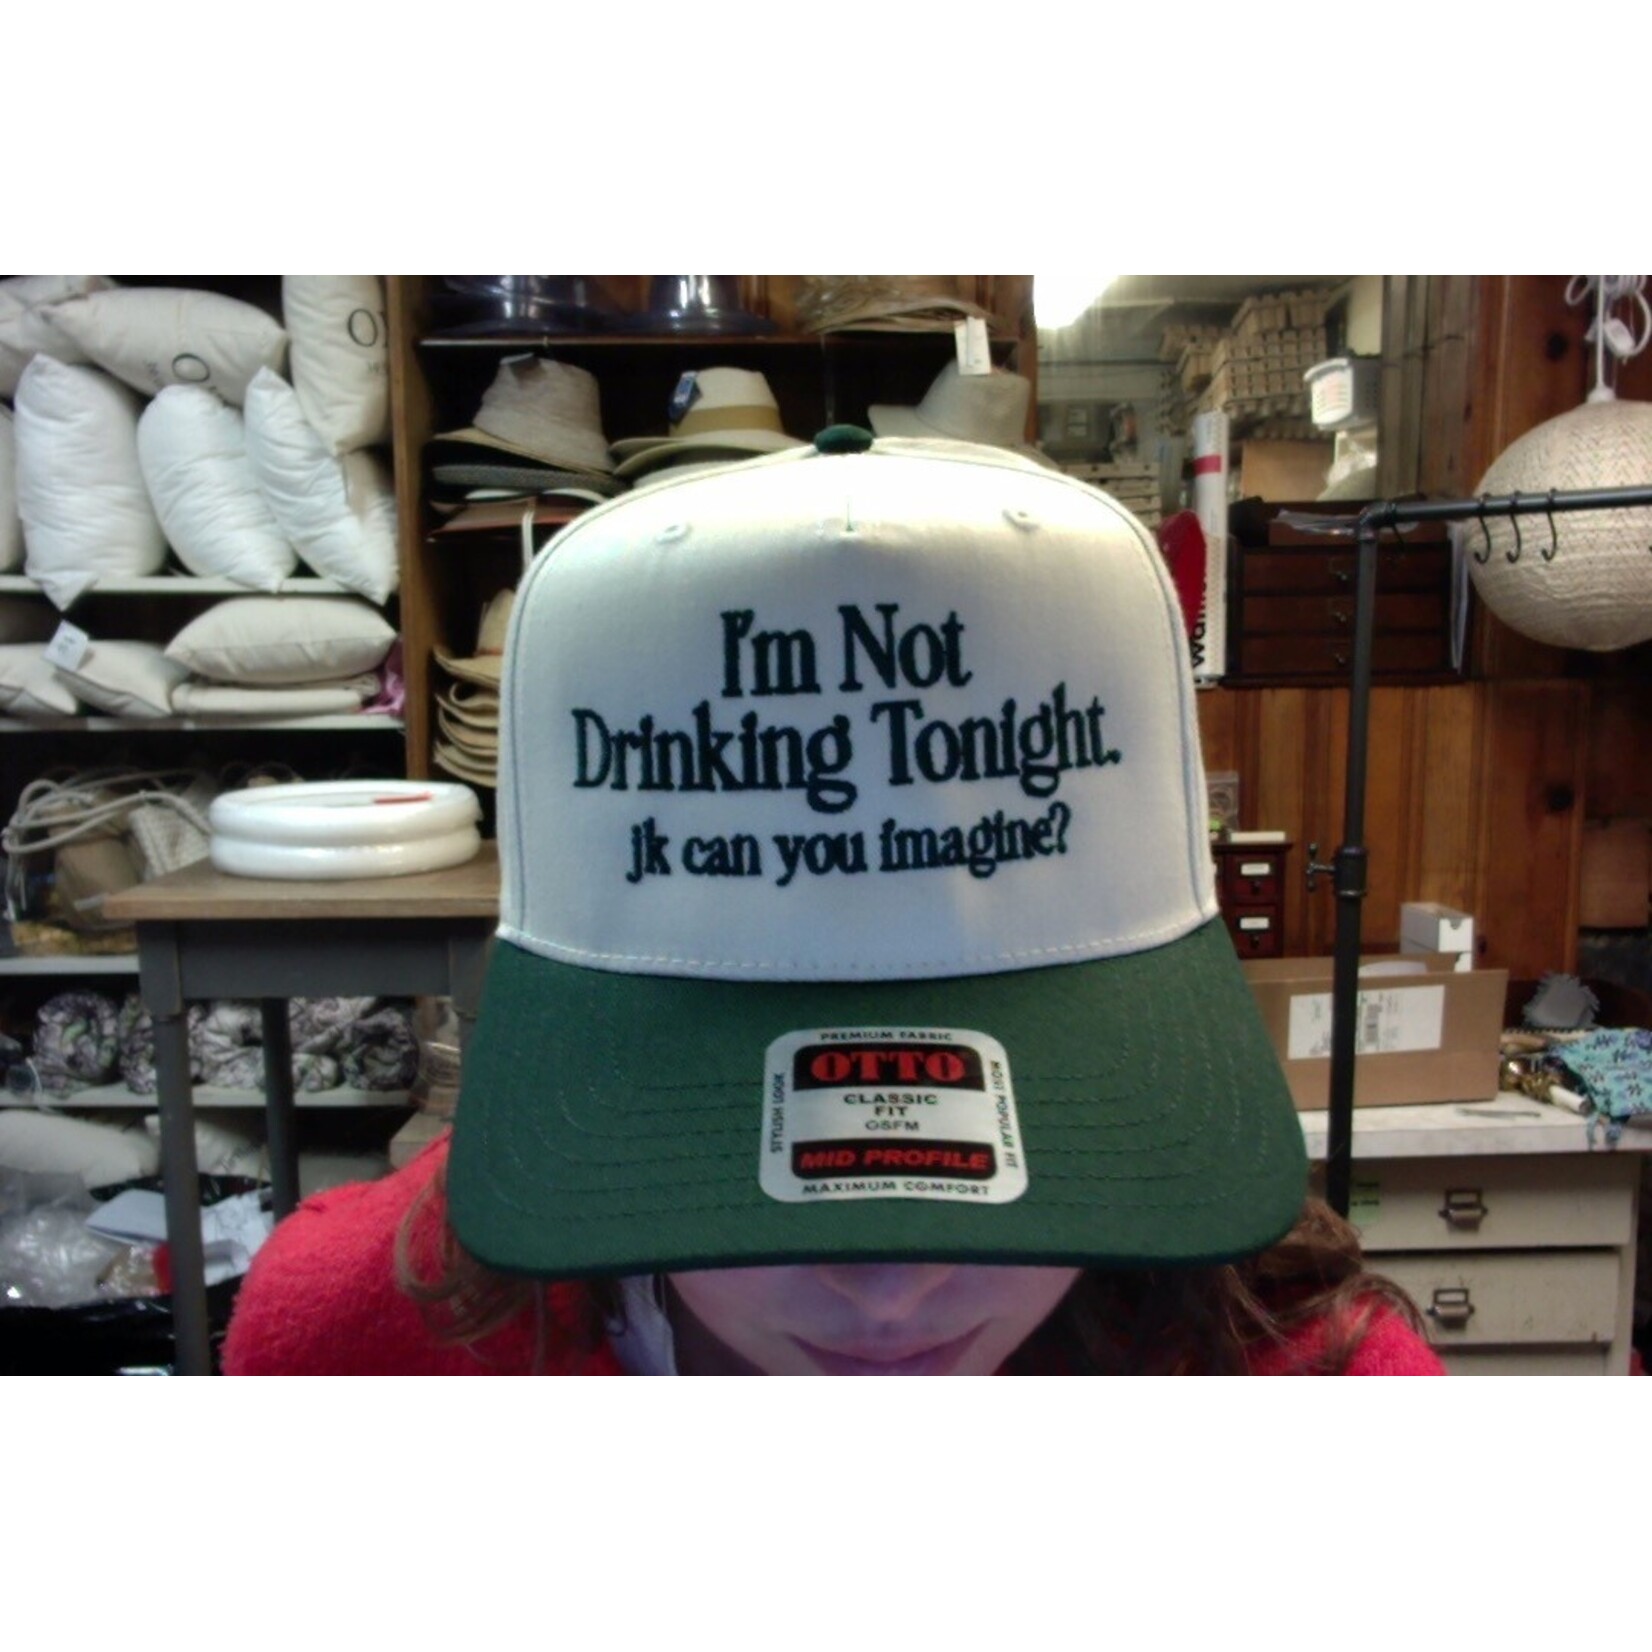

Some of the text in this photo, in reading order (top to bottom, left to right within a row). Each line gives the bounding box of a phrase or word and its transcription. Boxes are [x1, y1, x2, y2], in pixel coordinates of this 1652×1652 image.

[720, 603, 973, 697] I'm Not
[571, 681, 1122, 813] Drinking Tonight.
[626, 801, 1072, 886] jk can you imagine?
[820, 1031, 953, 1041] PREMIUM FABRIC
[811, 1052, 966, 1082] OTTO
[843, 1094, 939, 1105] CLASSIC
[874, 1106, 909, 1116] FIT
[769, 1107, 784, 1153] STYLISH
[864, 1120, 920, 1132] OSFM
[801, 1149, 990, 1169] MID PROFILE
[802, 1182, 990, 1196] MAXIMUM COMFORT
